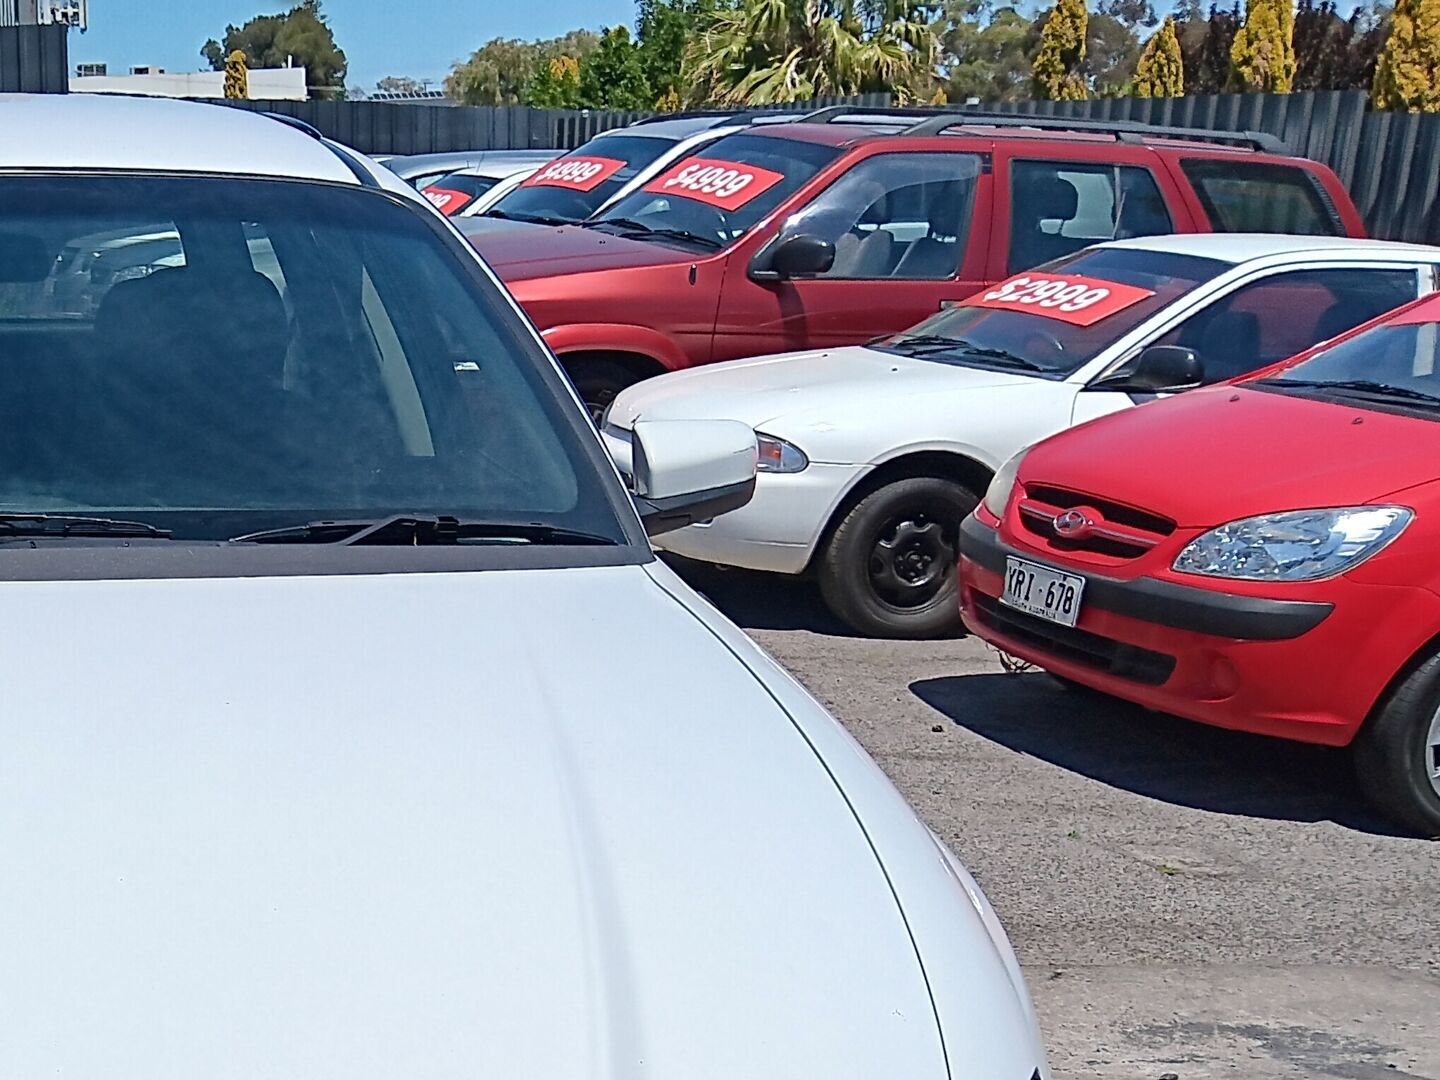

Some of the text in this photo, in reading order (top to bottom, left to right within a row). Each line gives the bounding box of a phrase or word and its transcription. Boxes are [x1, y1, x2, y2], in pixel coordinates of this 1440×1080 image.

[533, 160, 604, 184] $4999
[662, 163, 754, 198] $4999
[981, 276, 1111, 313] $2999
[1044, 580, 1075, 615] 678
